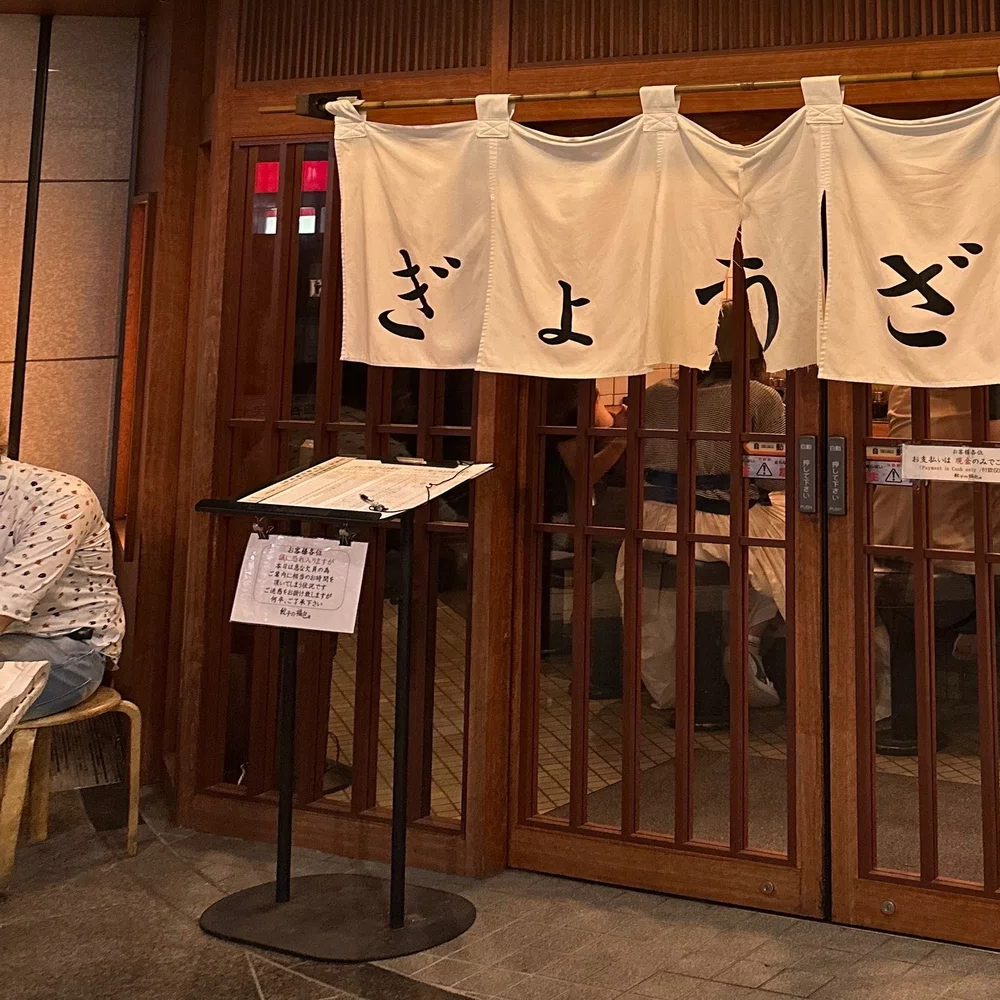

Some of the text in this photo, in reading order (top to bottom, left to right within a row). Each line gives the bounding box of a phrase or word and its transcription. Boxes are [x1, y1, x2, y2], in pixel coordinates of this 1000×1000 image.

[952, 449, 984, 457] お客様各位
[912, 455, 951, 464] お支払いは
[802, 459, 811, 499] 押して下さい
[831, 461, 840, 501] 押して下さい
[287, 547, 323, 556] お客様各位
